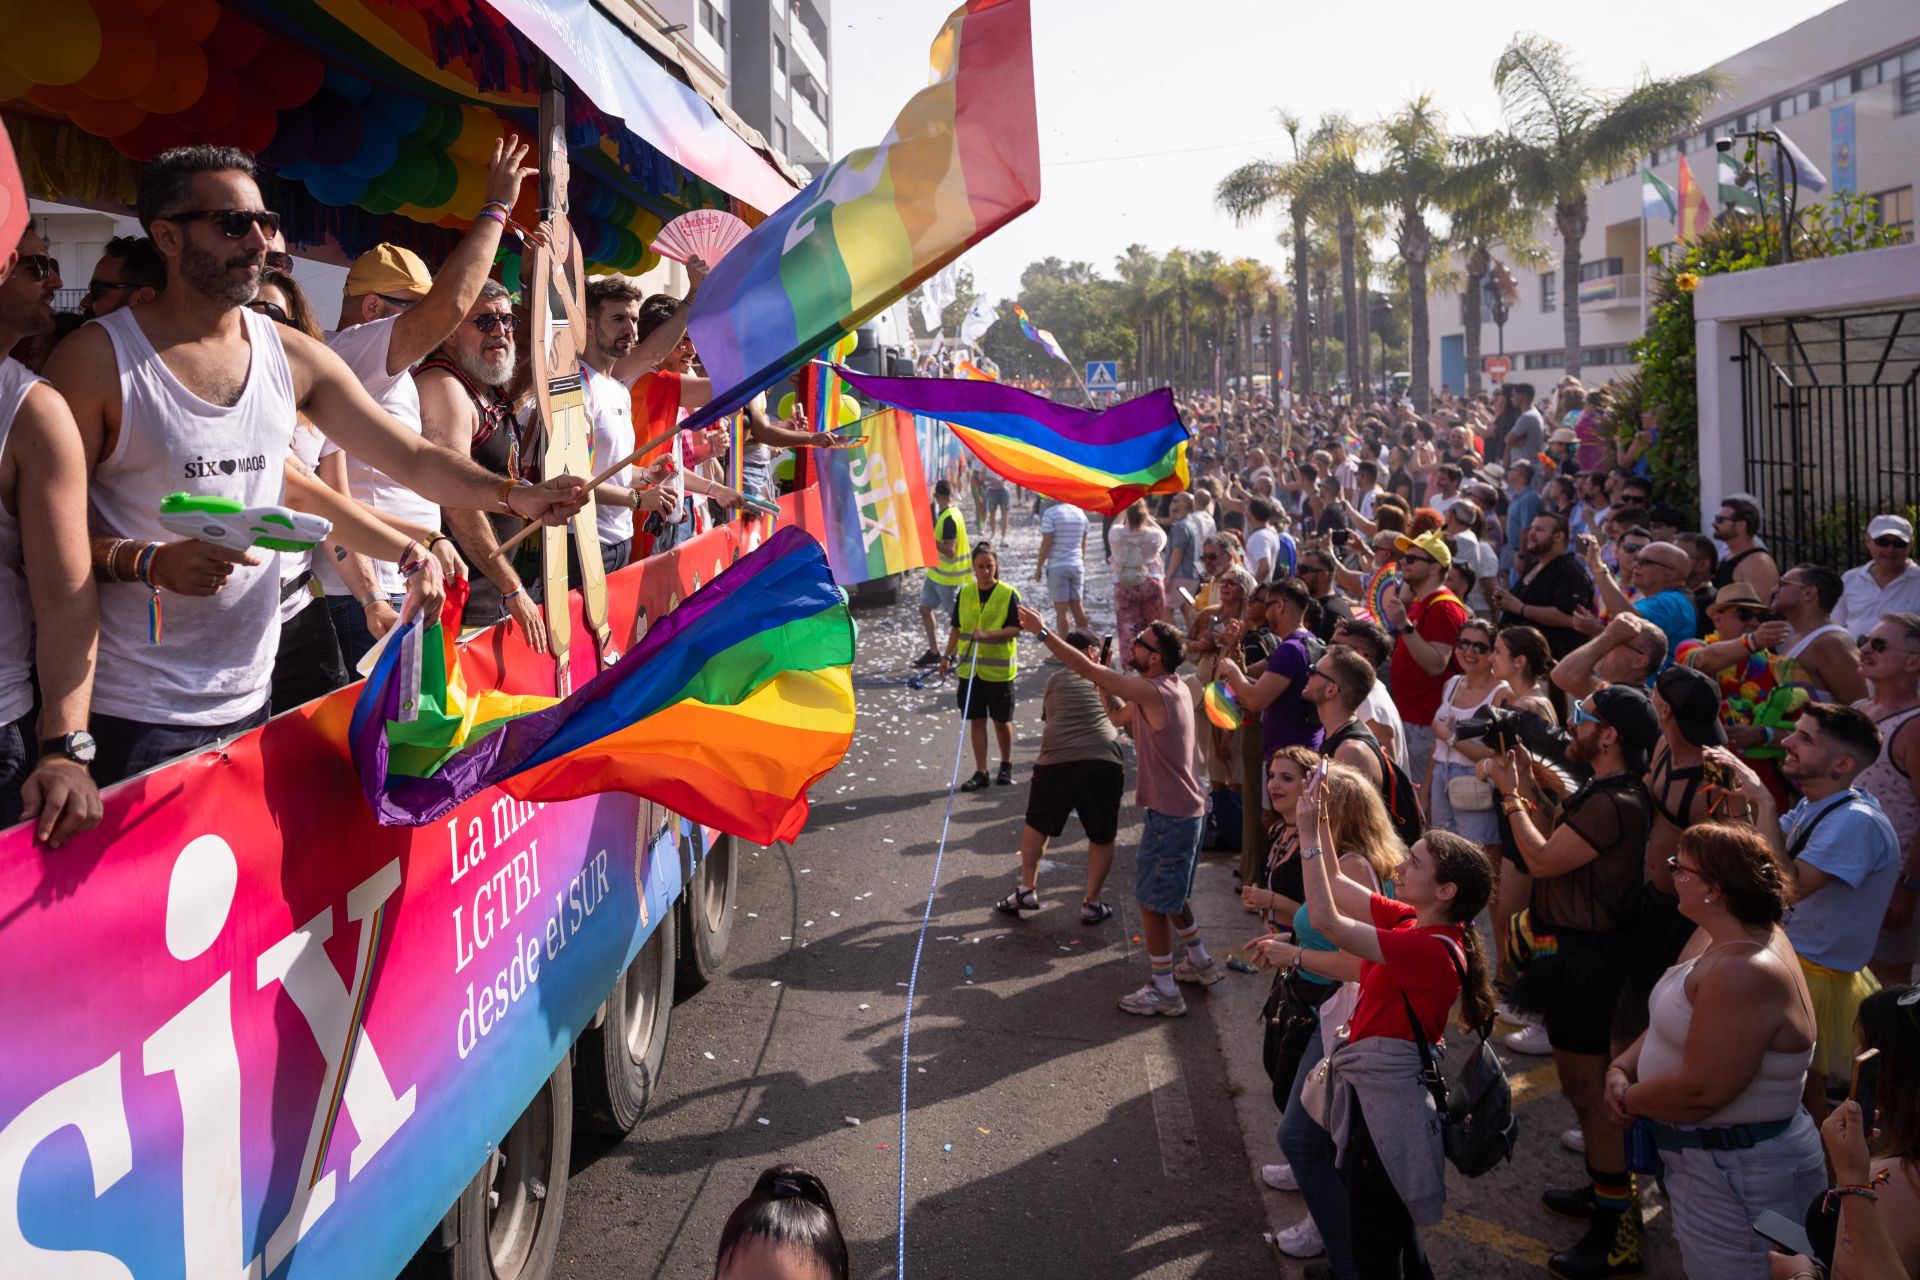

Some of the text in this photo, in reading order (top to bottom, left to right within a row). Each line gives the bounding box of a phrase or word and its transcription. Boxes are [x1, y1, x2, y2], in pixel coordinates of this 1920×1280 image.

[184, 456, 220, 479] six
[849, 453, 907, 554] six
[448, 815, 487, 885] La
[452, 839, 541, 974] LGTBI
[457, 849, 610, 1060] desde el SUR
